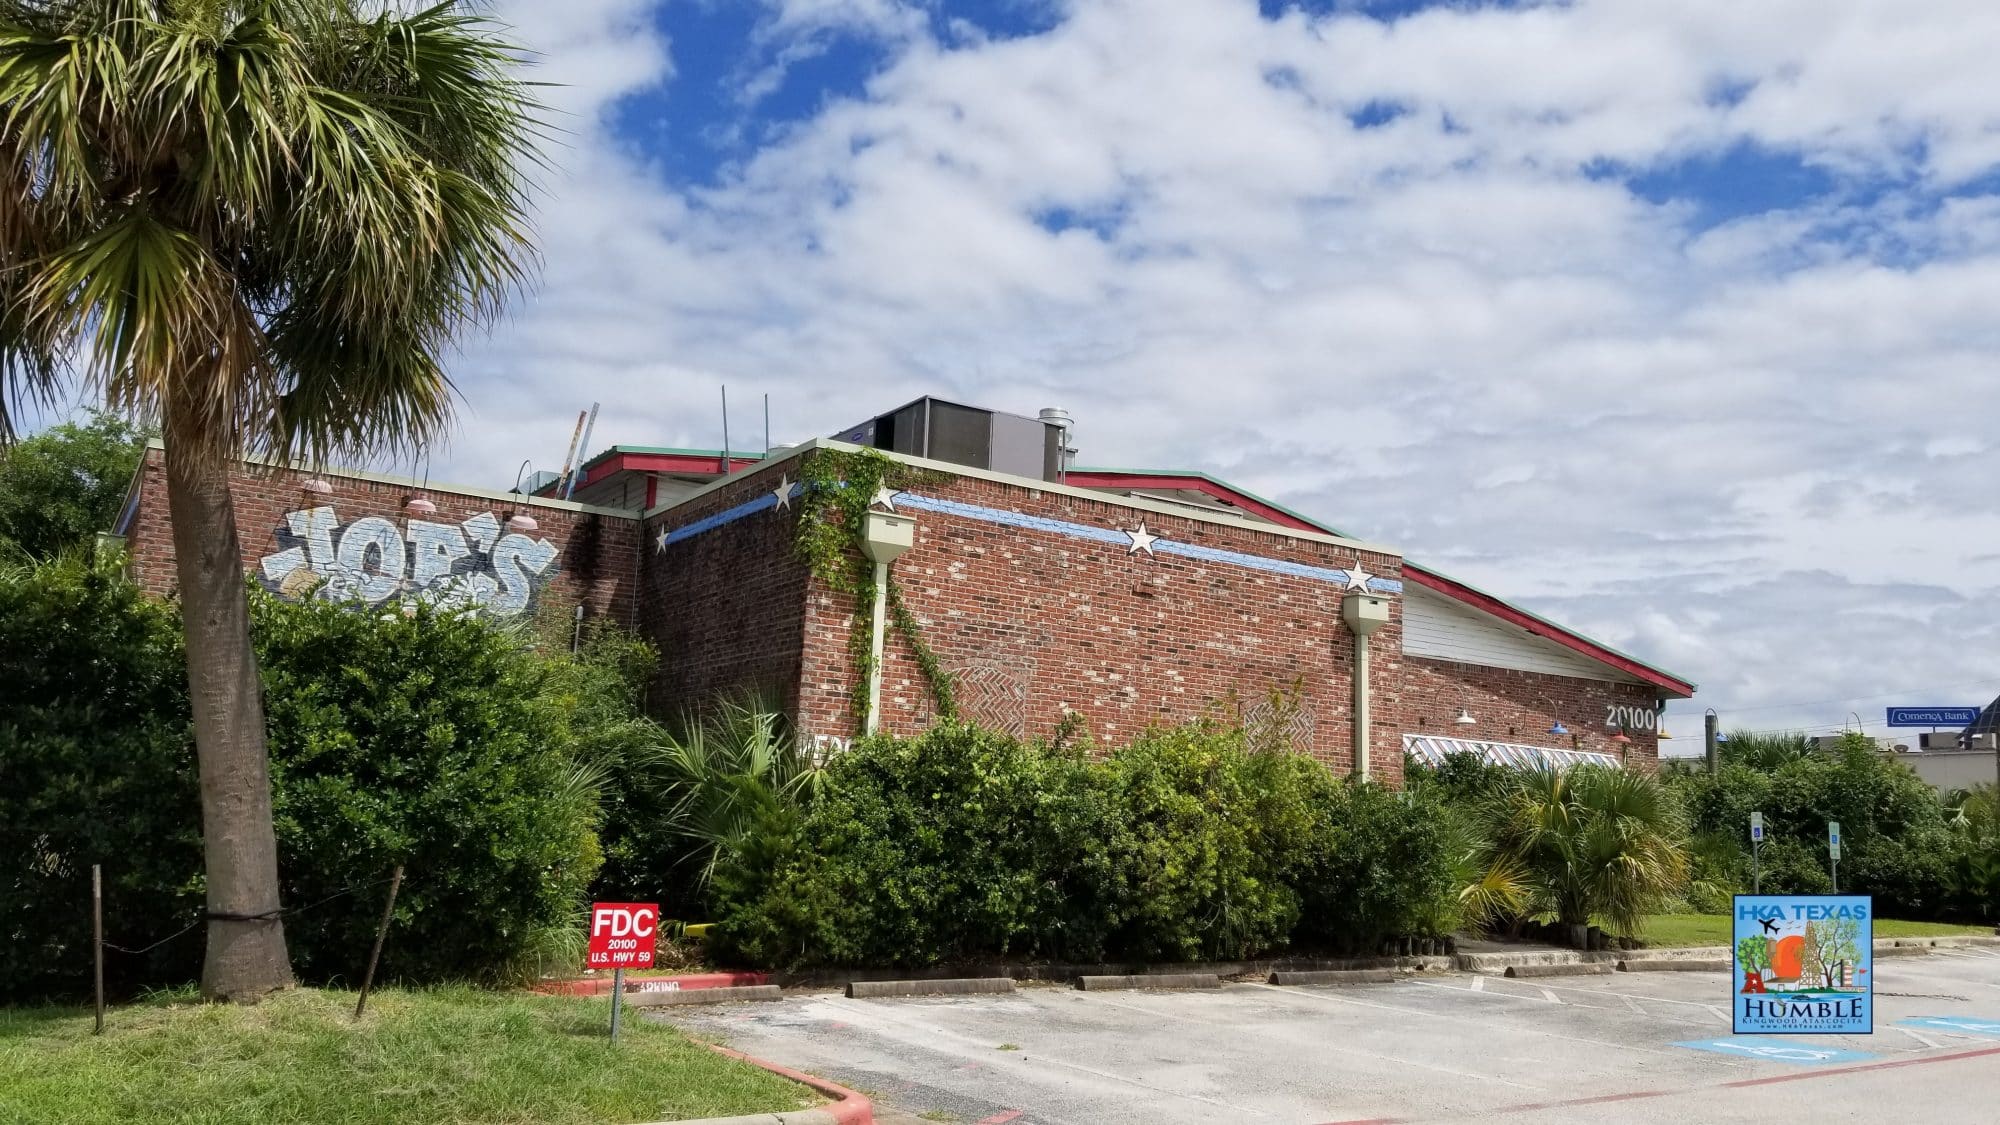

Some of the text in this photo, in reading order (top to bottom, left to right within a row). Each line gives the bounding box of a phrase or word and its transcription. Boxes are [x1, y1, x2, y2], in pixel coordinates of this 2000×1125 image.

[1606, 705, 1655, 730] 20100
[1944, 712, 1969, 720] Bank
[593, 909, 654, 937] FDC
[608, 939, 637, 950] 20100
[591, 951, 651, 962] U.S. HWY 59
